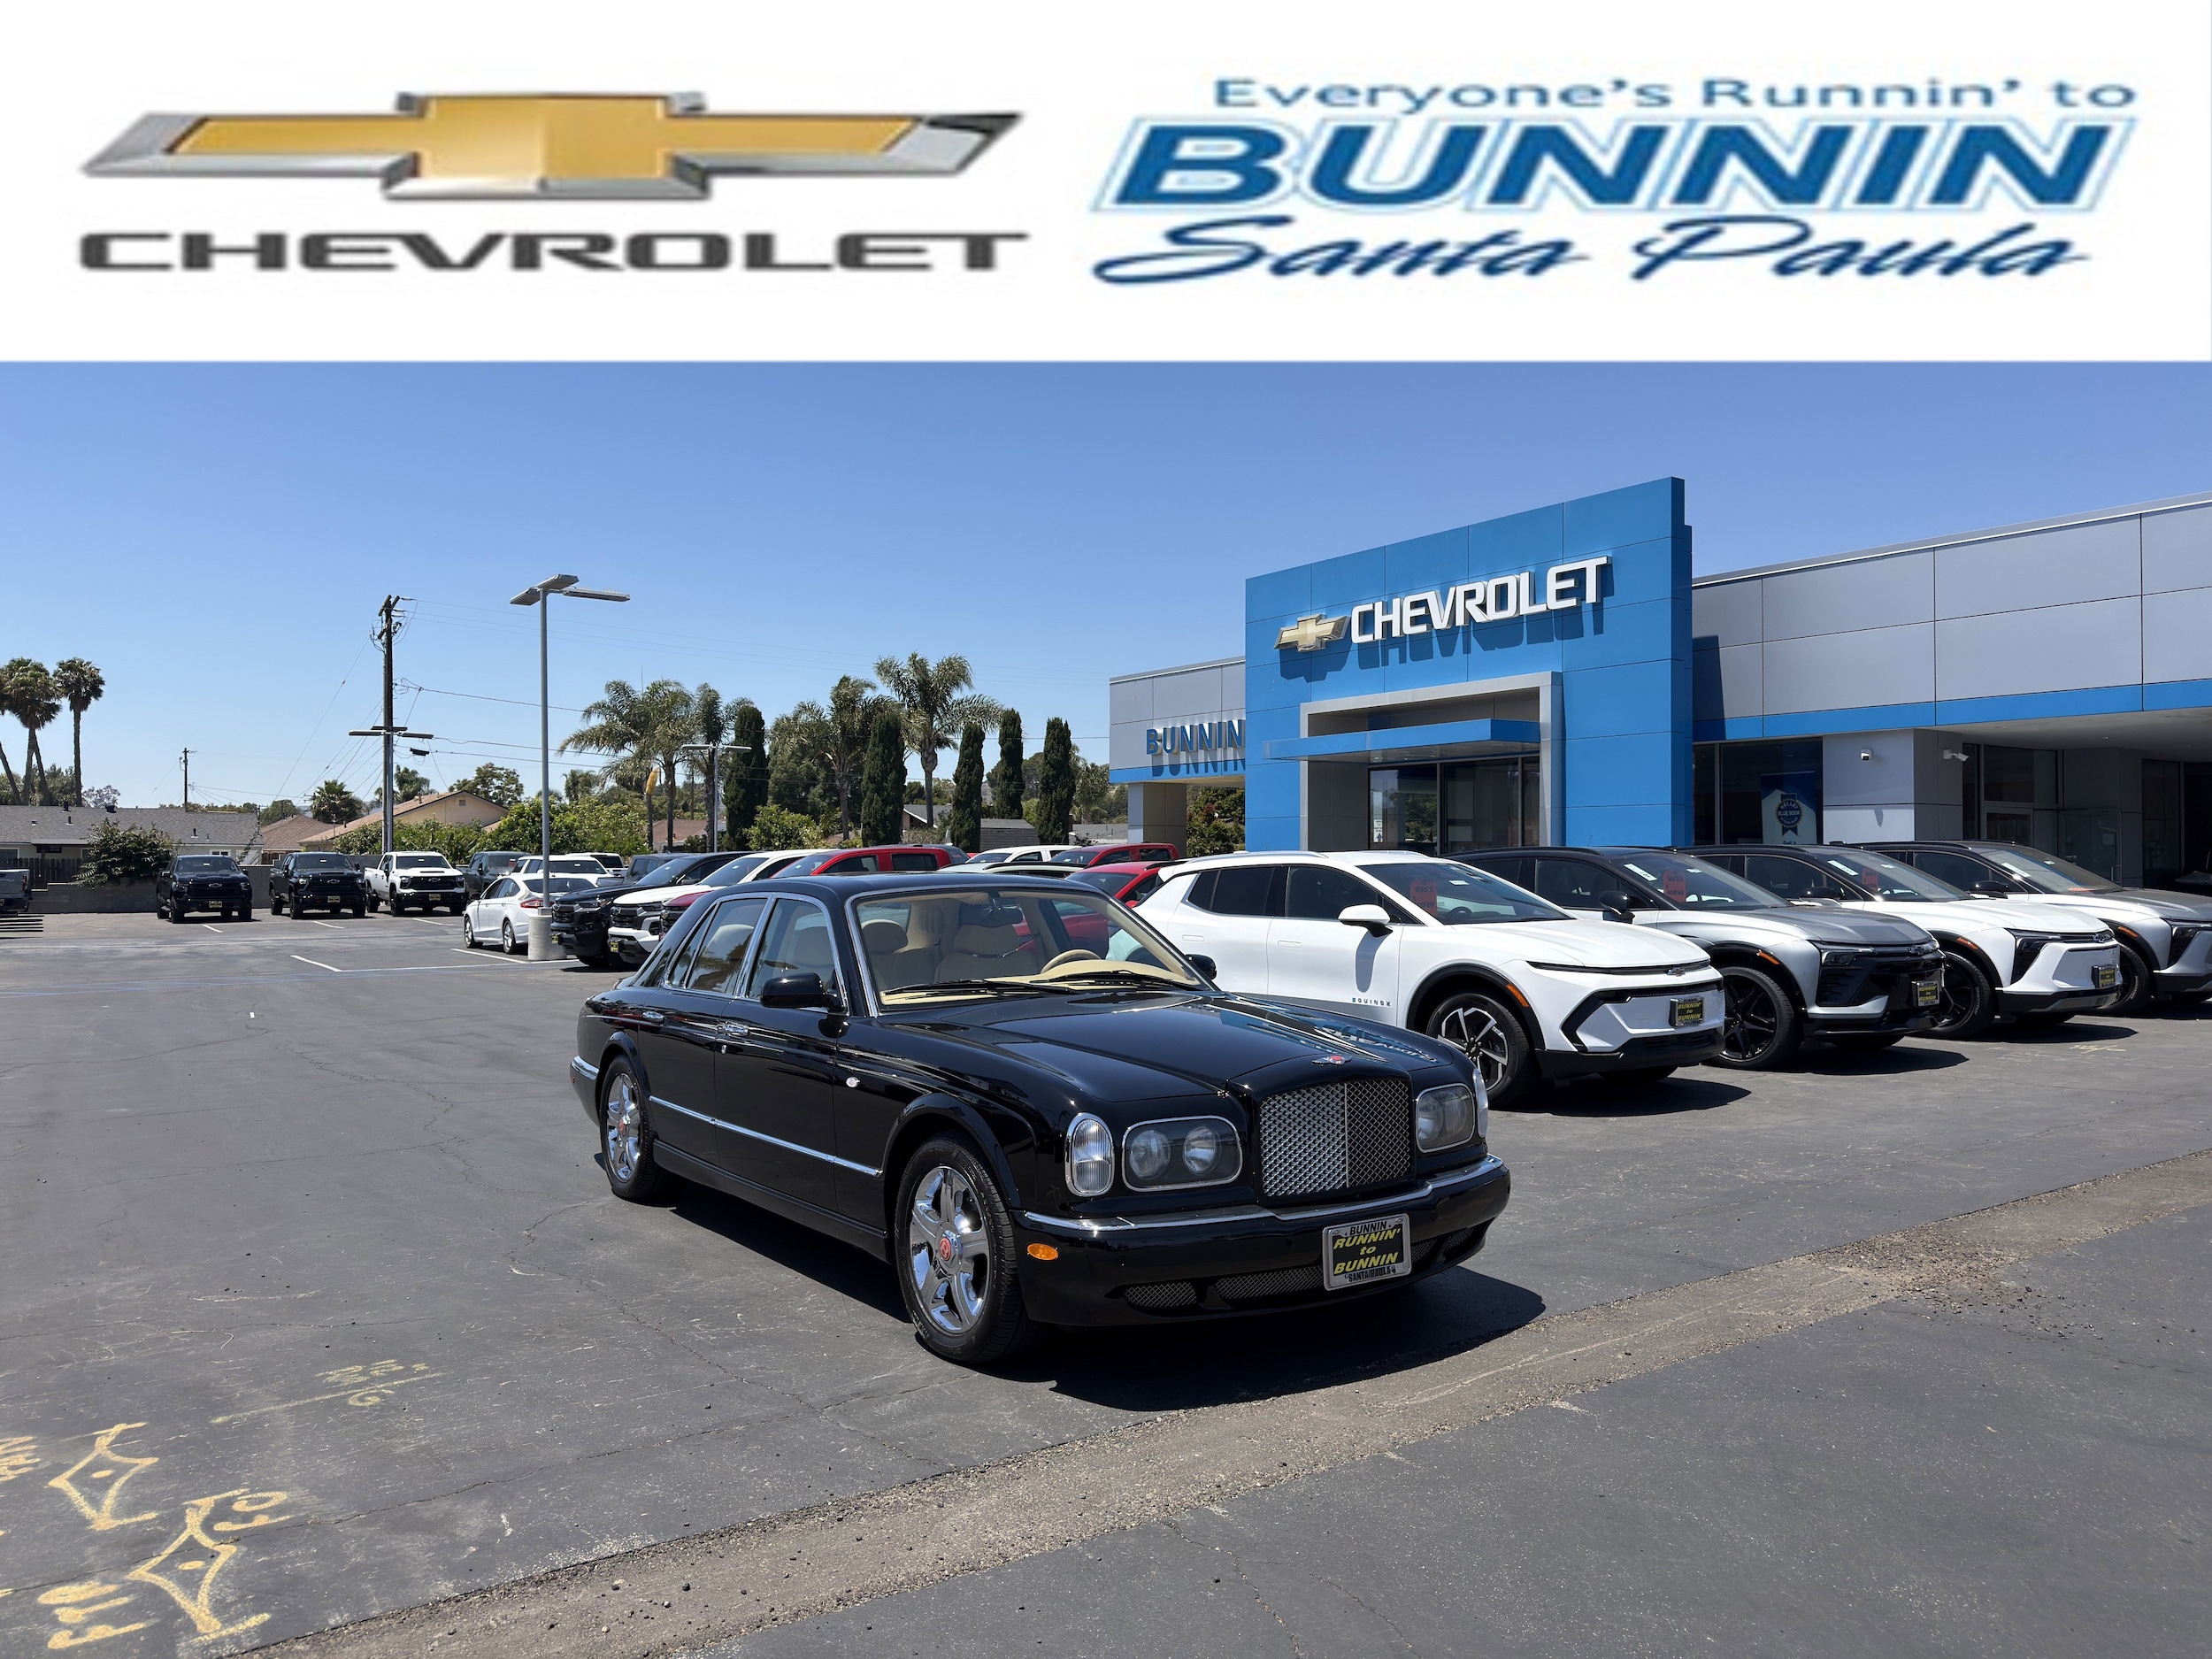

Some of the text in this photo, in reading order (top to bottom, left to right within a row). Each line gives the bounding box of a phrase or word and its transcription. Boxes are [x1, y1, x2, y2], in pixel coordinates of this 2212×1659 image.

[1350, 556, 1612, 645] CHEVROLET
[1146, 718, 1244, 756] BUNNIN
[1333, 1228, 1401, 1249] RUNNIN'
[1349, 1221, 1386, 1236] BUNNIN
[1359, 1246, 1377, 1256] to
[1333, 1252, 1399, 1274] BUNNIN
